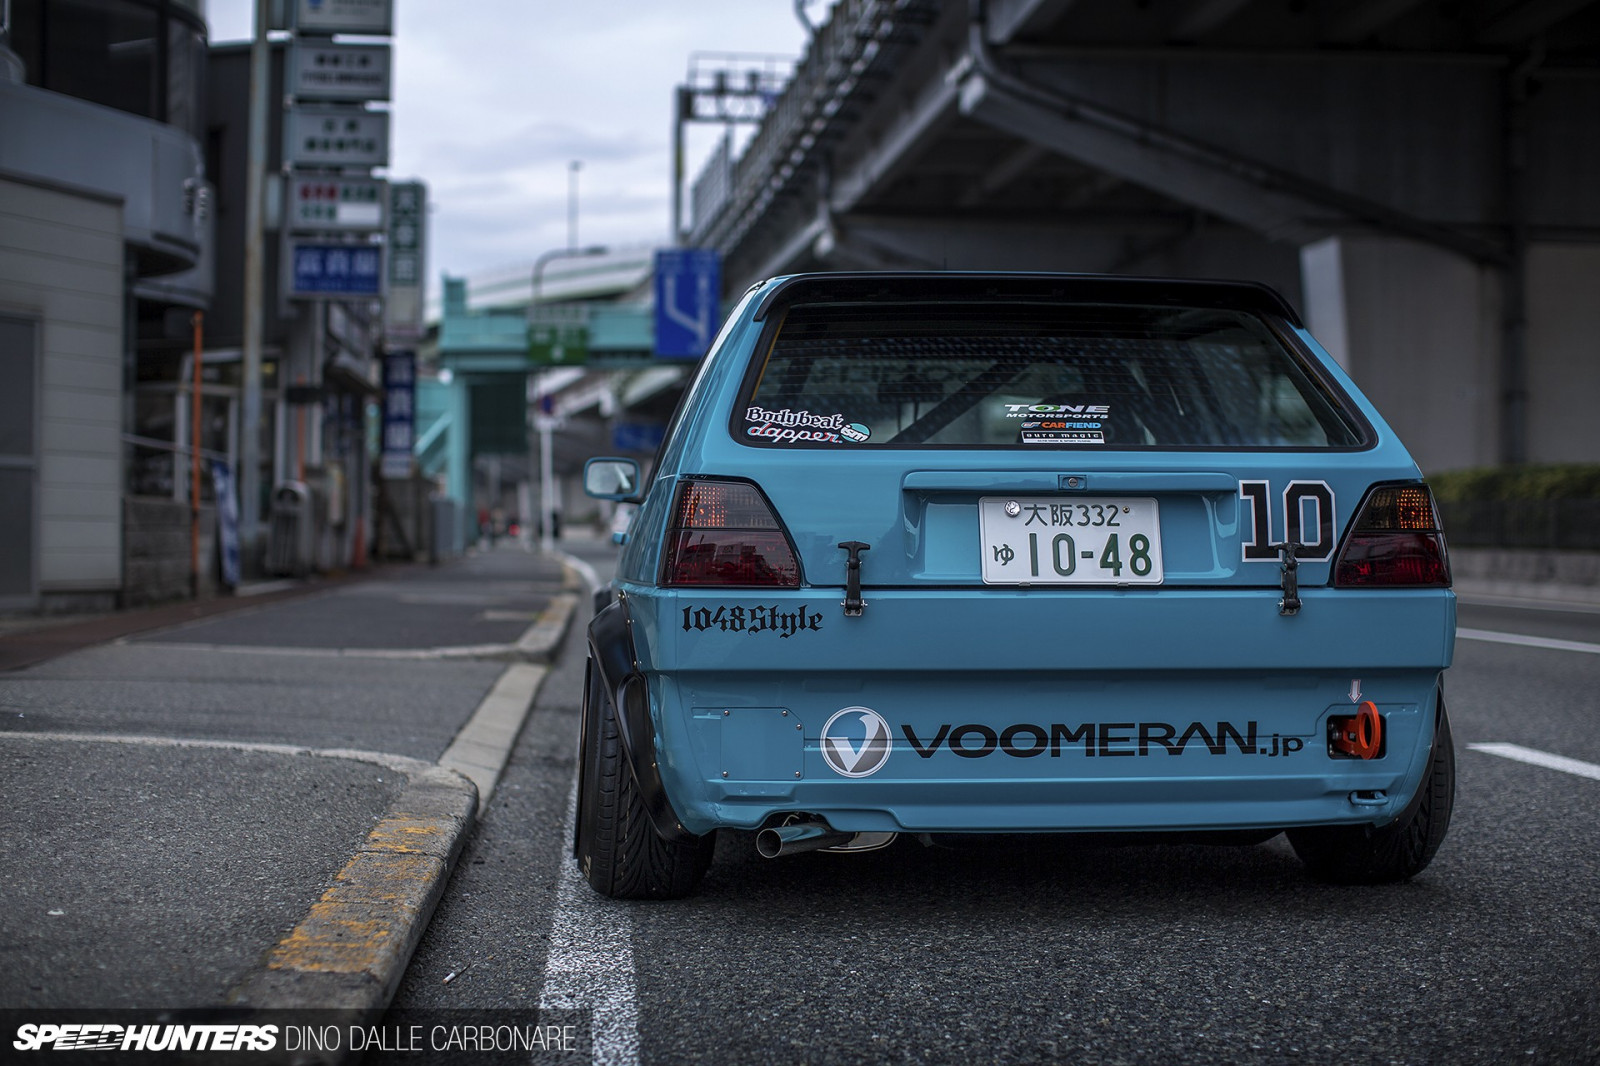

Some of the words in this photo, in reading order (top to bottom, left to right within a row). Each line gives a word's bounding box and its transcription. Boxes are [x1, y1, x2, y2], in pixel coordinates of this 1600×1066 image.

[745, 406, 844, 429] Bodybeat
[1004, 404, 1111, 413] TONE
[840, 424, 869, 442] ism
[1239, 479, 1337, 563] 10
[992, 543, 1015, 566] ゆ
[1028, 532, 1152, 577] 10-48
[681, 604, 824, 639] 1048Style
